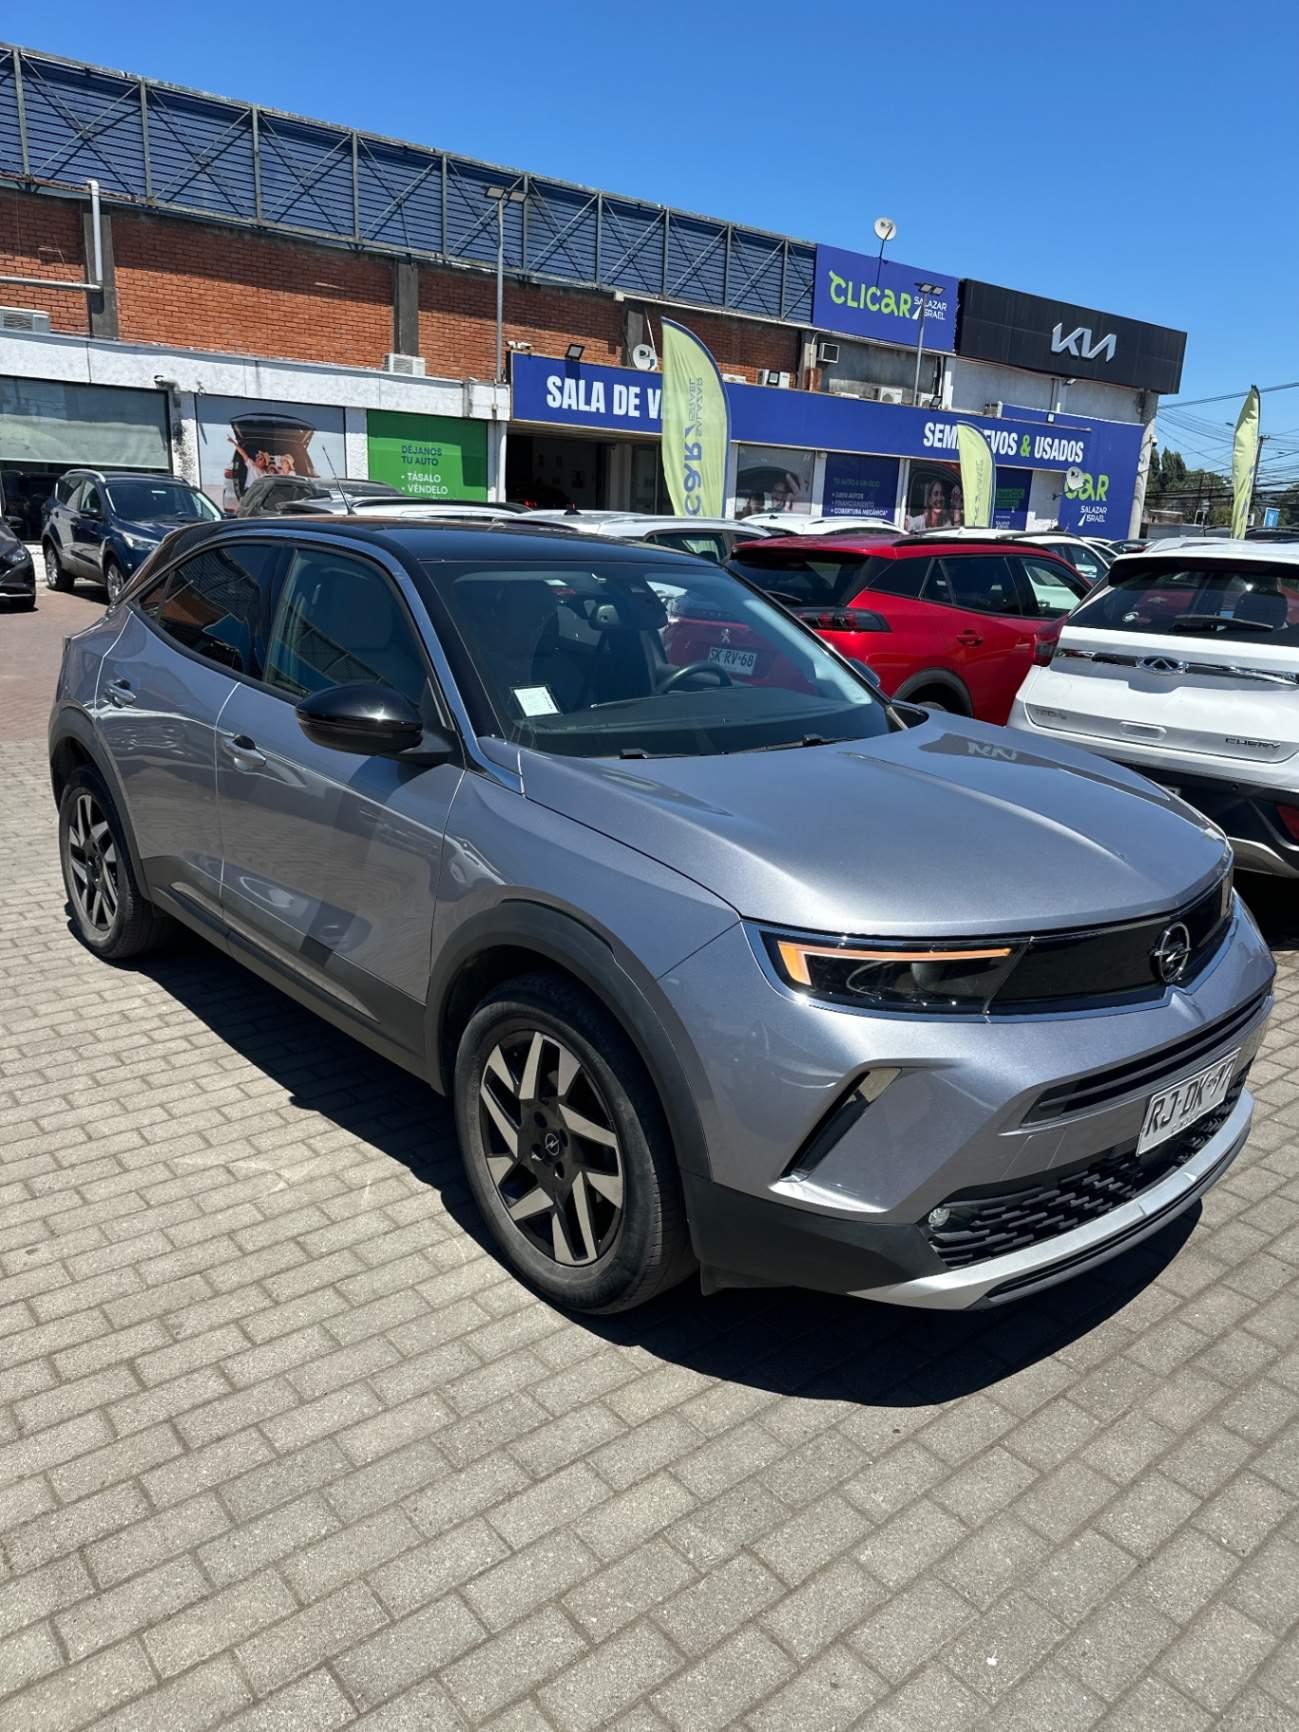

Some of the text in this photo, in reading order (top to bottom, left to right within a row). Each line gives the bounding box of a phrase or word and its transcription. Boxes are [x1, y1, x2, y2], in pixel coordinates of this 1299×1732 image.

[1051, 322, 1117, 362] KIA
[546, 375, 663, 420] SALA DE V
[401, 444, 442, 456] DÉJANOS
[1020, 434, 1031, 457] &
[1034, 436, 1084, 463] USADOS
[401, 455, 438, 466] TU AUTO
[407, 470, 441, 483] TÁSALO
[407, 483, 448, 495] VÉNDELO
[1080, 505, 1107, 514] SALAZAR
[1086, 514, 1105, 523] ISRAEL
